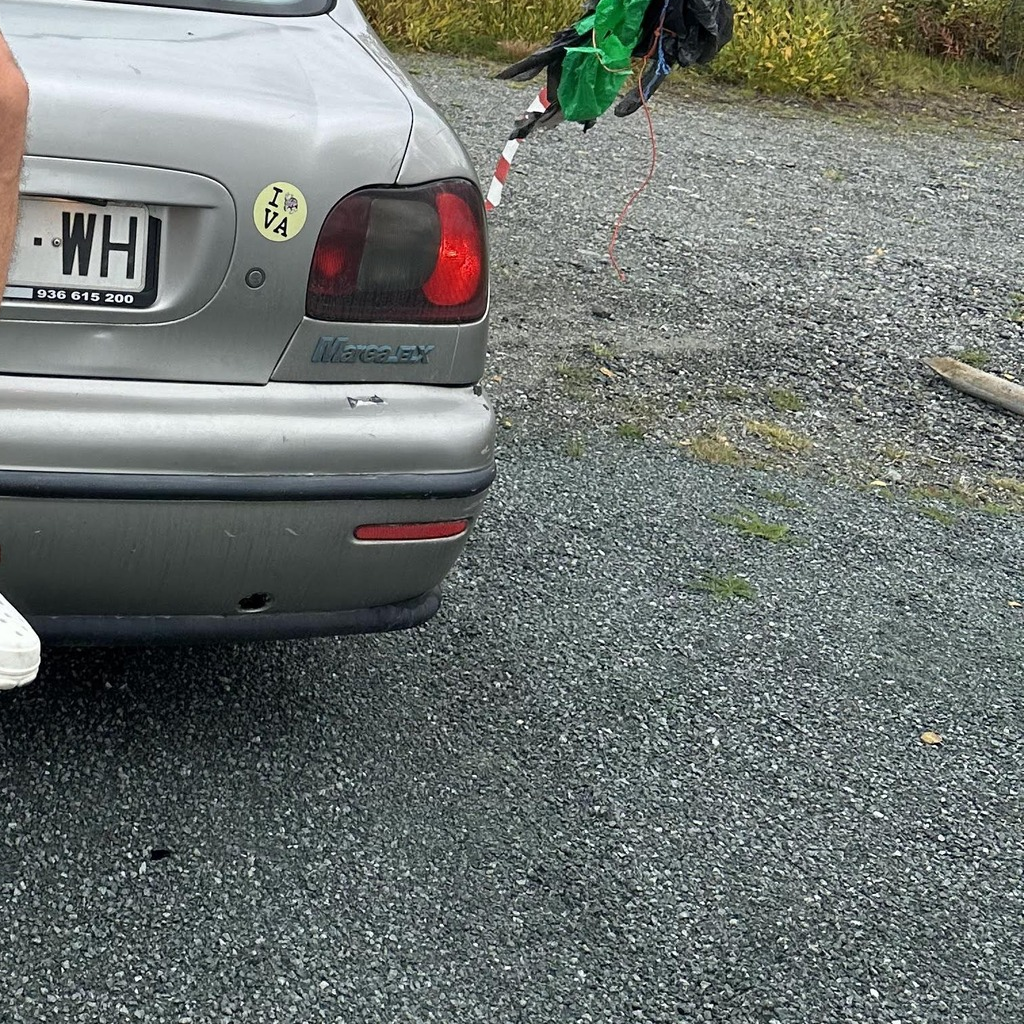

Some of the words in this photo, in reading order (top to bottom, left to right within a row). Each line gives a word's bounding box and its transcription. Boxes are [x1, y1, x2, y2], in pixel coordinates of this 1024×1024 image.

[268, 186, 283, 208] I
[265, 208, 287, 237] VA
[37, 289, 67, 300] 936
[71, 291, 100, 302] 615
[104, 292, 134, 304] 200
